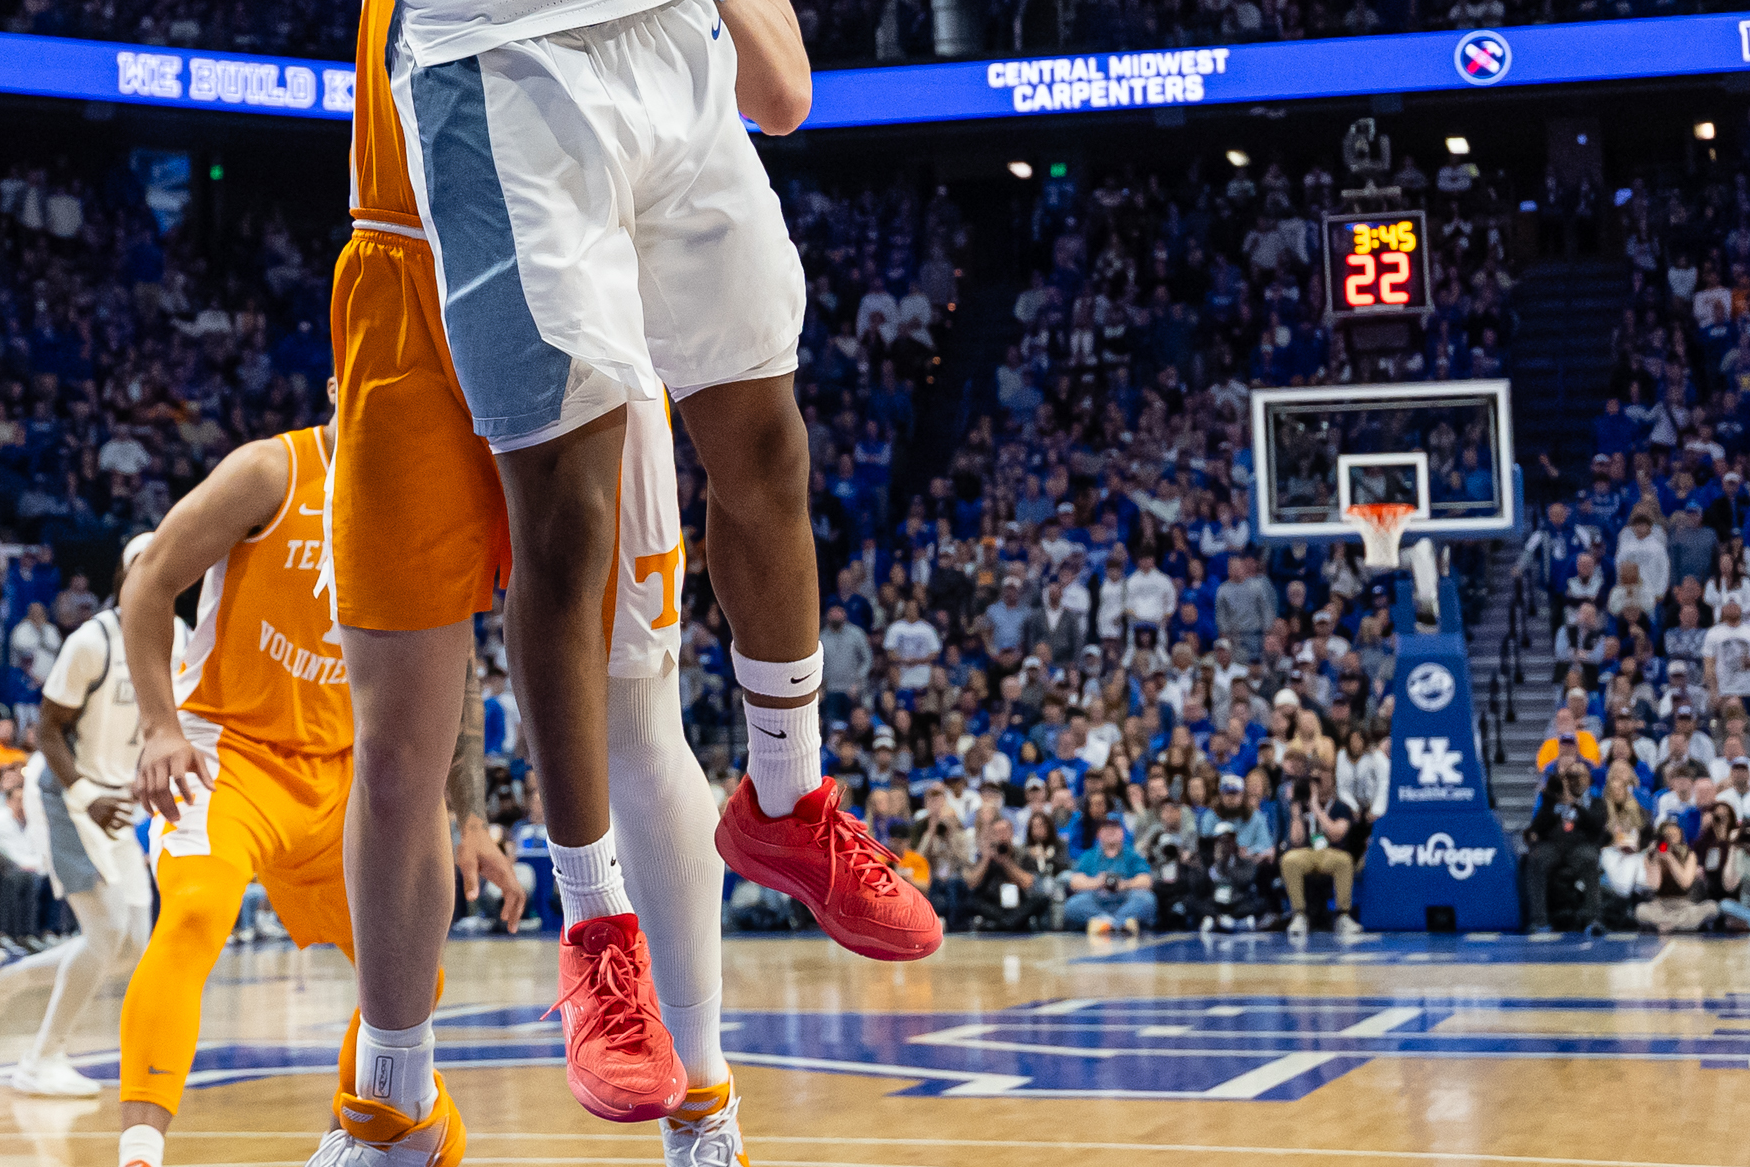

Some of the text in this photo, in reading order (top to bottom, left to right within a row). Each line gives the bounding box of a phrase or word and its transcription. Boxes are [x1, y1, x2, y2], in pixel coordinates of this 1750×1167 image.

[116, 51, 184, 99] WE
[189, 57, 317, 109] BUILD
[987, 47, 1230, 89] CENTRAL MIDWEST
[1013, 73, 1205, 113] CARPENTERS
[1353, 221, 1416, 255] 3:45
[1345, 252, 1410, 307] 22
[1405, 736, 1463, 785] UK
